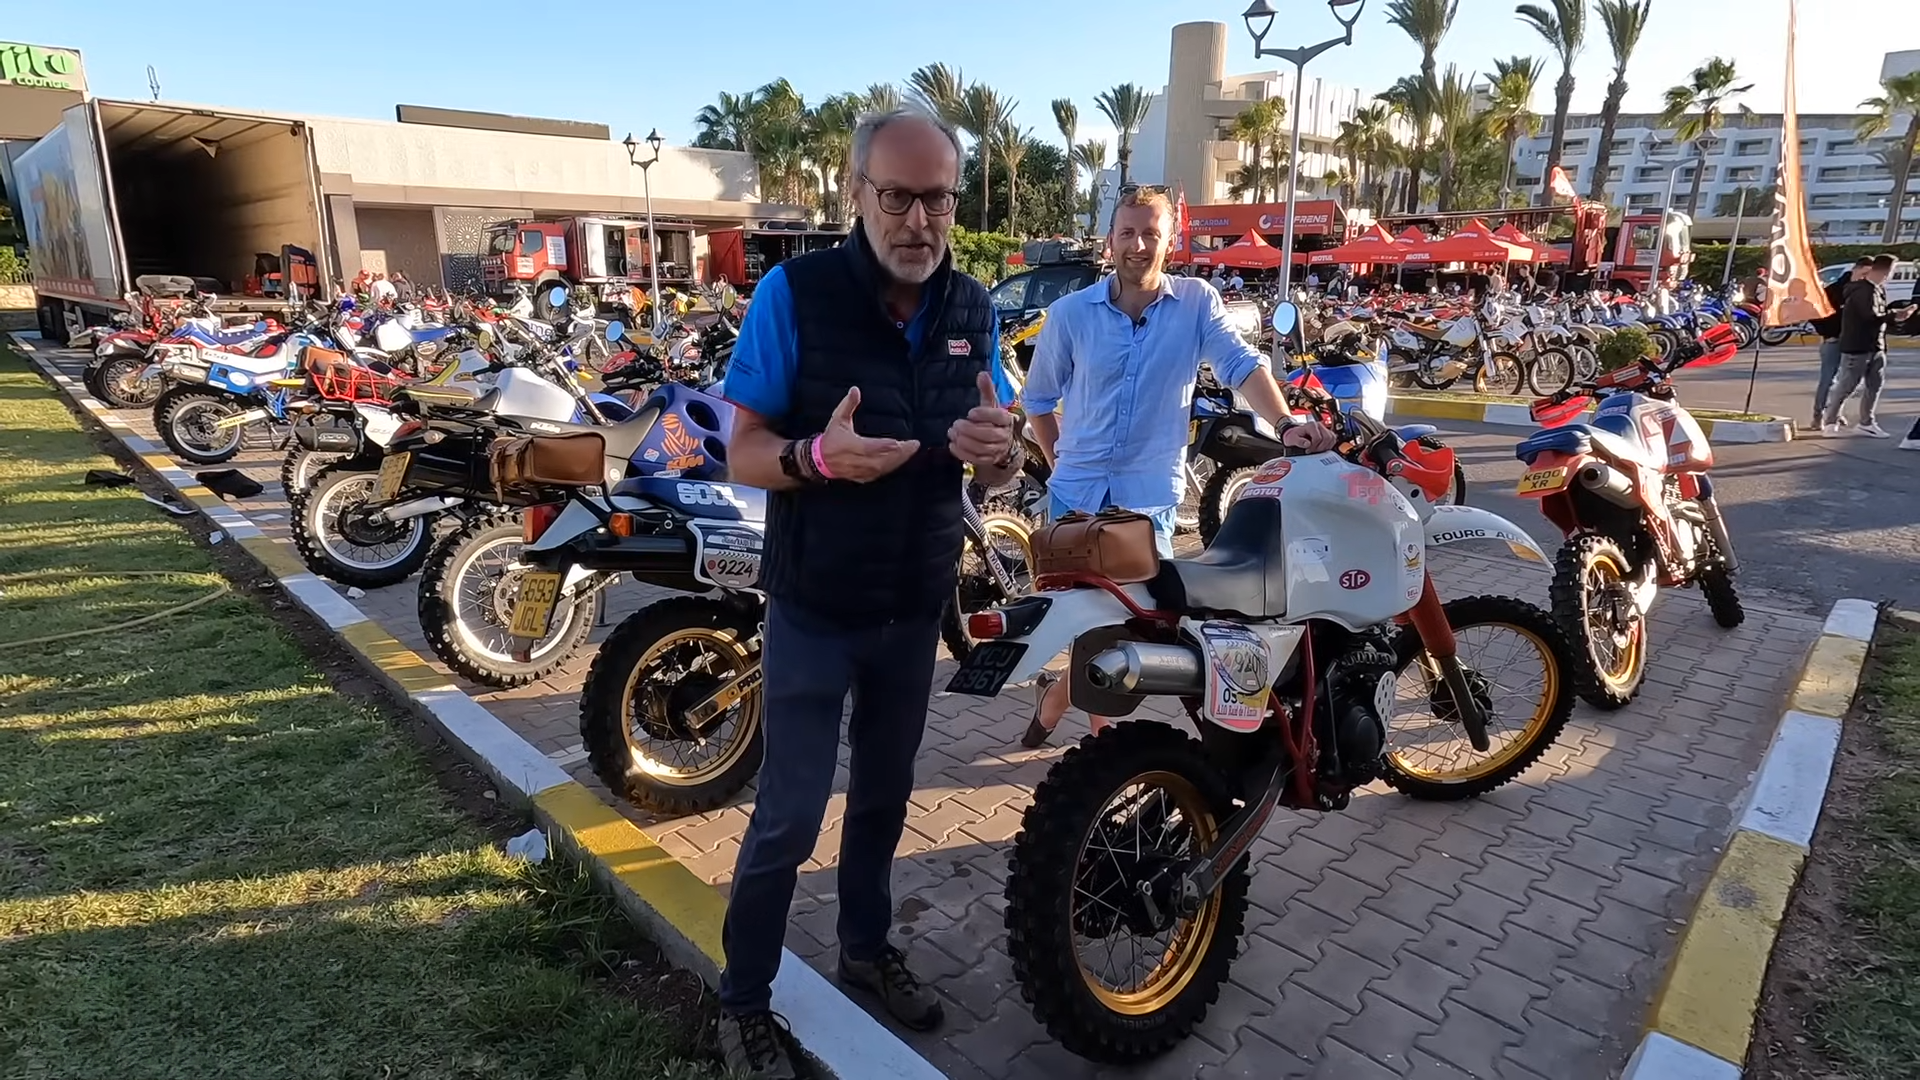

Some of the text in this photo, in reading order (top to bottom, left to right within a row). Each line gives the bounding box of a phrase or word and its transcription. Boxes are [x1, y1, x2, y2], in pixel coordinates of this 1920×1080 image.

[16, 76, 71, 89] LOUNGE
[530, 421, 561, 434] KTM
[667, 455, 705, 471] KTM
[1523, 470, 1561, 482] K600
[1530, 478, 1549, 490] XR
[676, 483, 748, 509] 600L
[1242, 487, 1280, 497] MOTUL
[1432, 529, 1486, 544] FOURG
[717, 559, 753, 578] 9224
[1341, 571, 1366, 588] STP
[514, 605, 538, 632] JGL
[951, 668, 1009, 692] 696Y
